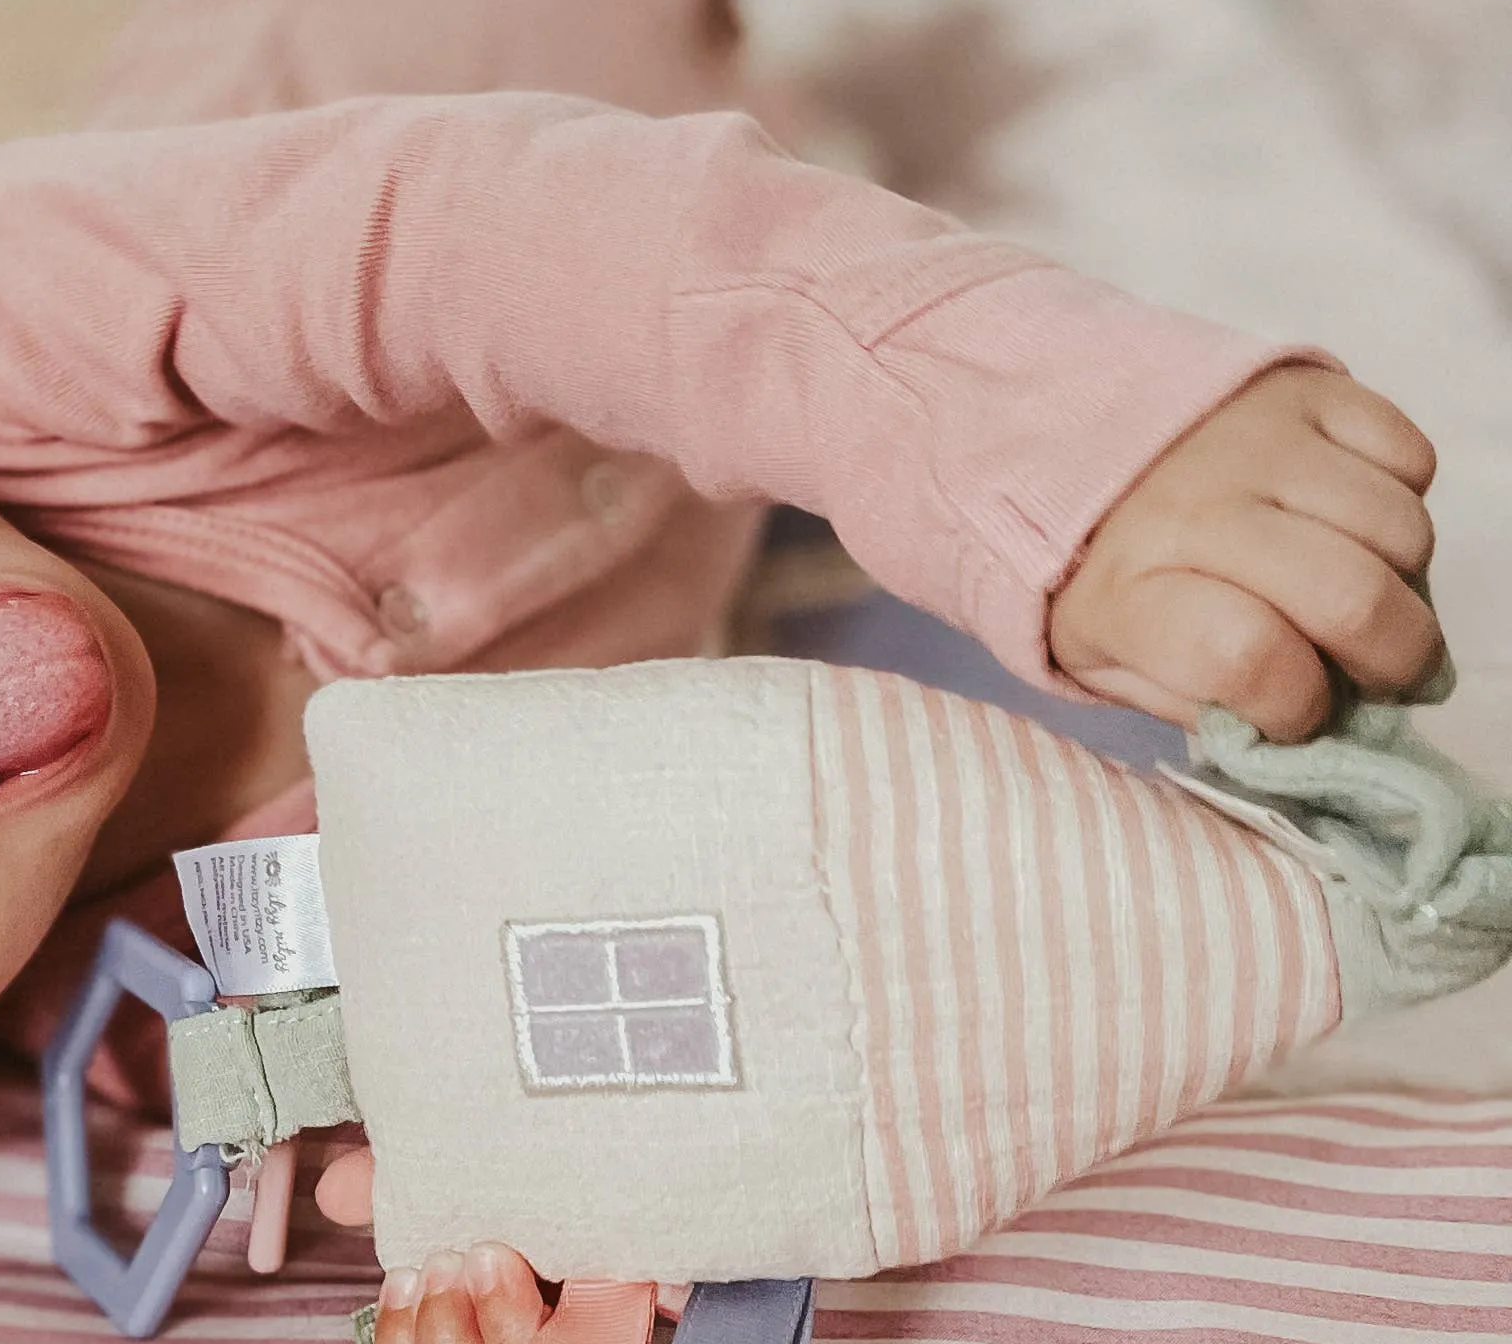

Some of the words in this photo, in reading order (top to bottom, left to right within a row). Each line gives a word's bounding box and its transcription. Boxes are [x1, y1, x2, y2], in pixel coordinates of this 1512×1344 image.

[229, 856, 239, 890] Made
[237, 855, 250, 911] Designed
[230, 907, 240, 942] China
[240, 915, 249, 927] in
[264, 893, 286, 925] itzy
[243, 929, 252, 955] USA
[267, 930, 296, 974] ritzy
